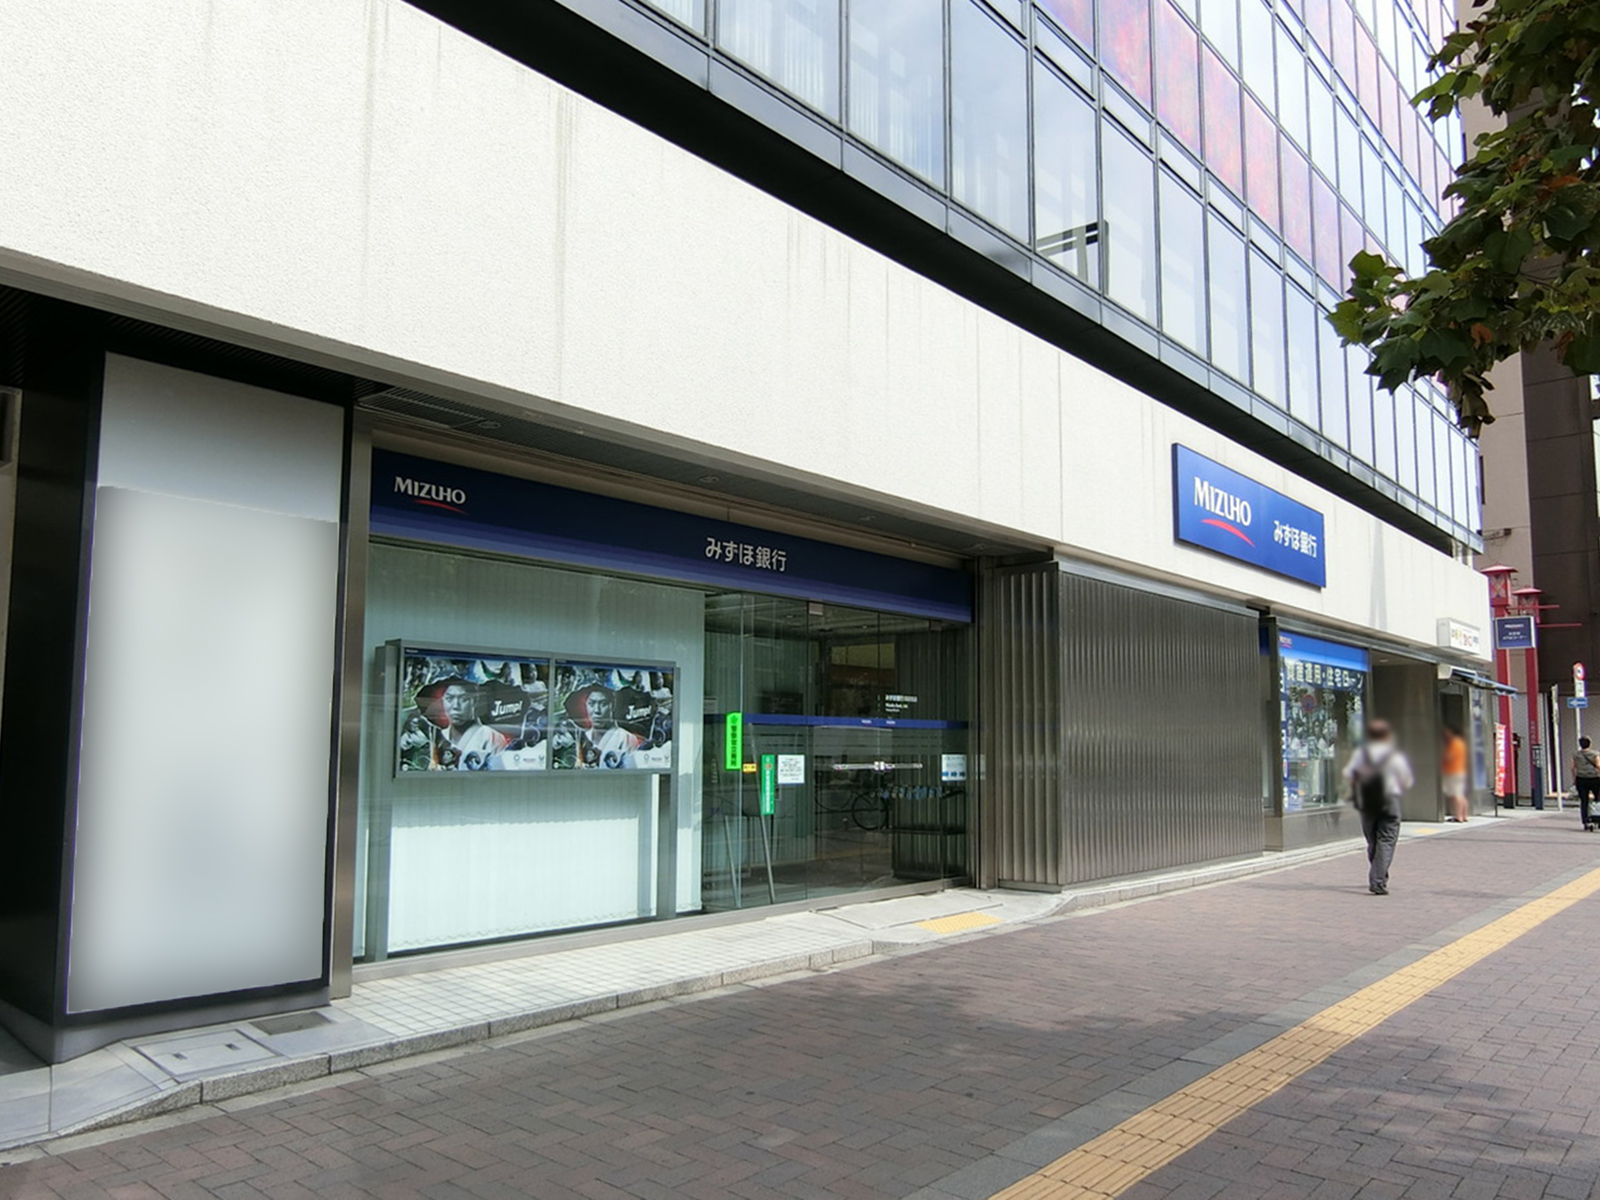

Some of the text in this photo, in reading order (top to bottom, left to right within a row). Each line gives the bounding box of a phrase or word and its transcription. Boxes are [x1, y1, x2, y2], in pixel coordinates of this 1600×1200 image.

[394, 476, 466, 504] MIZUHO
[1194, 476, 1251, 526] MIZUHO
[705, 537, 786, 571] みずほ銀行
[1273, 520, 1317, 558] みずほ銀行
